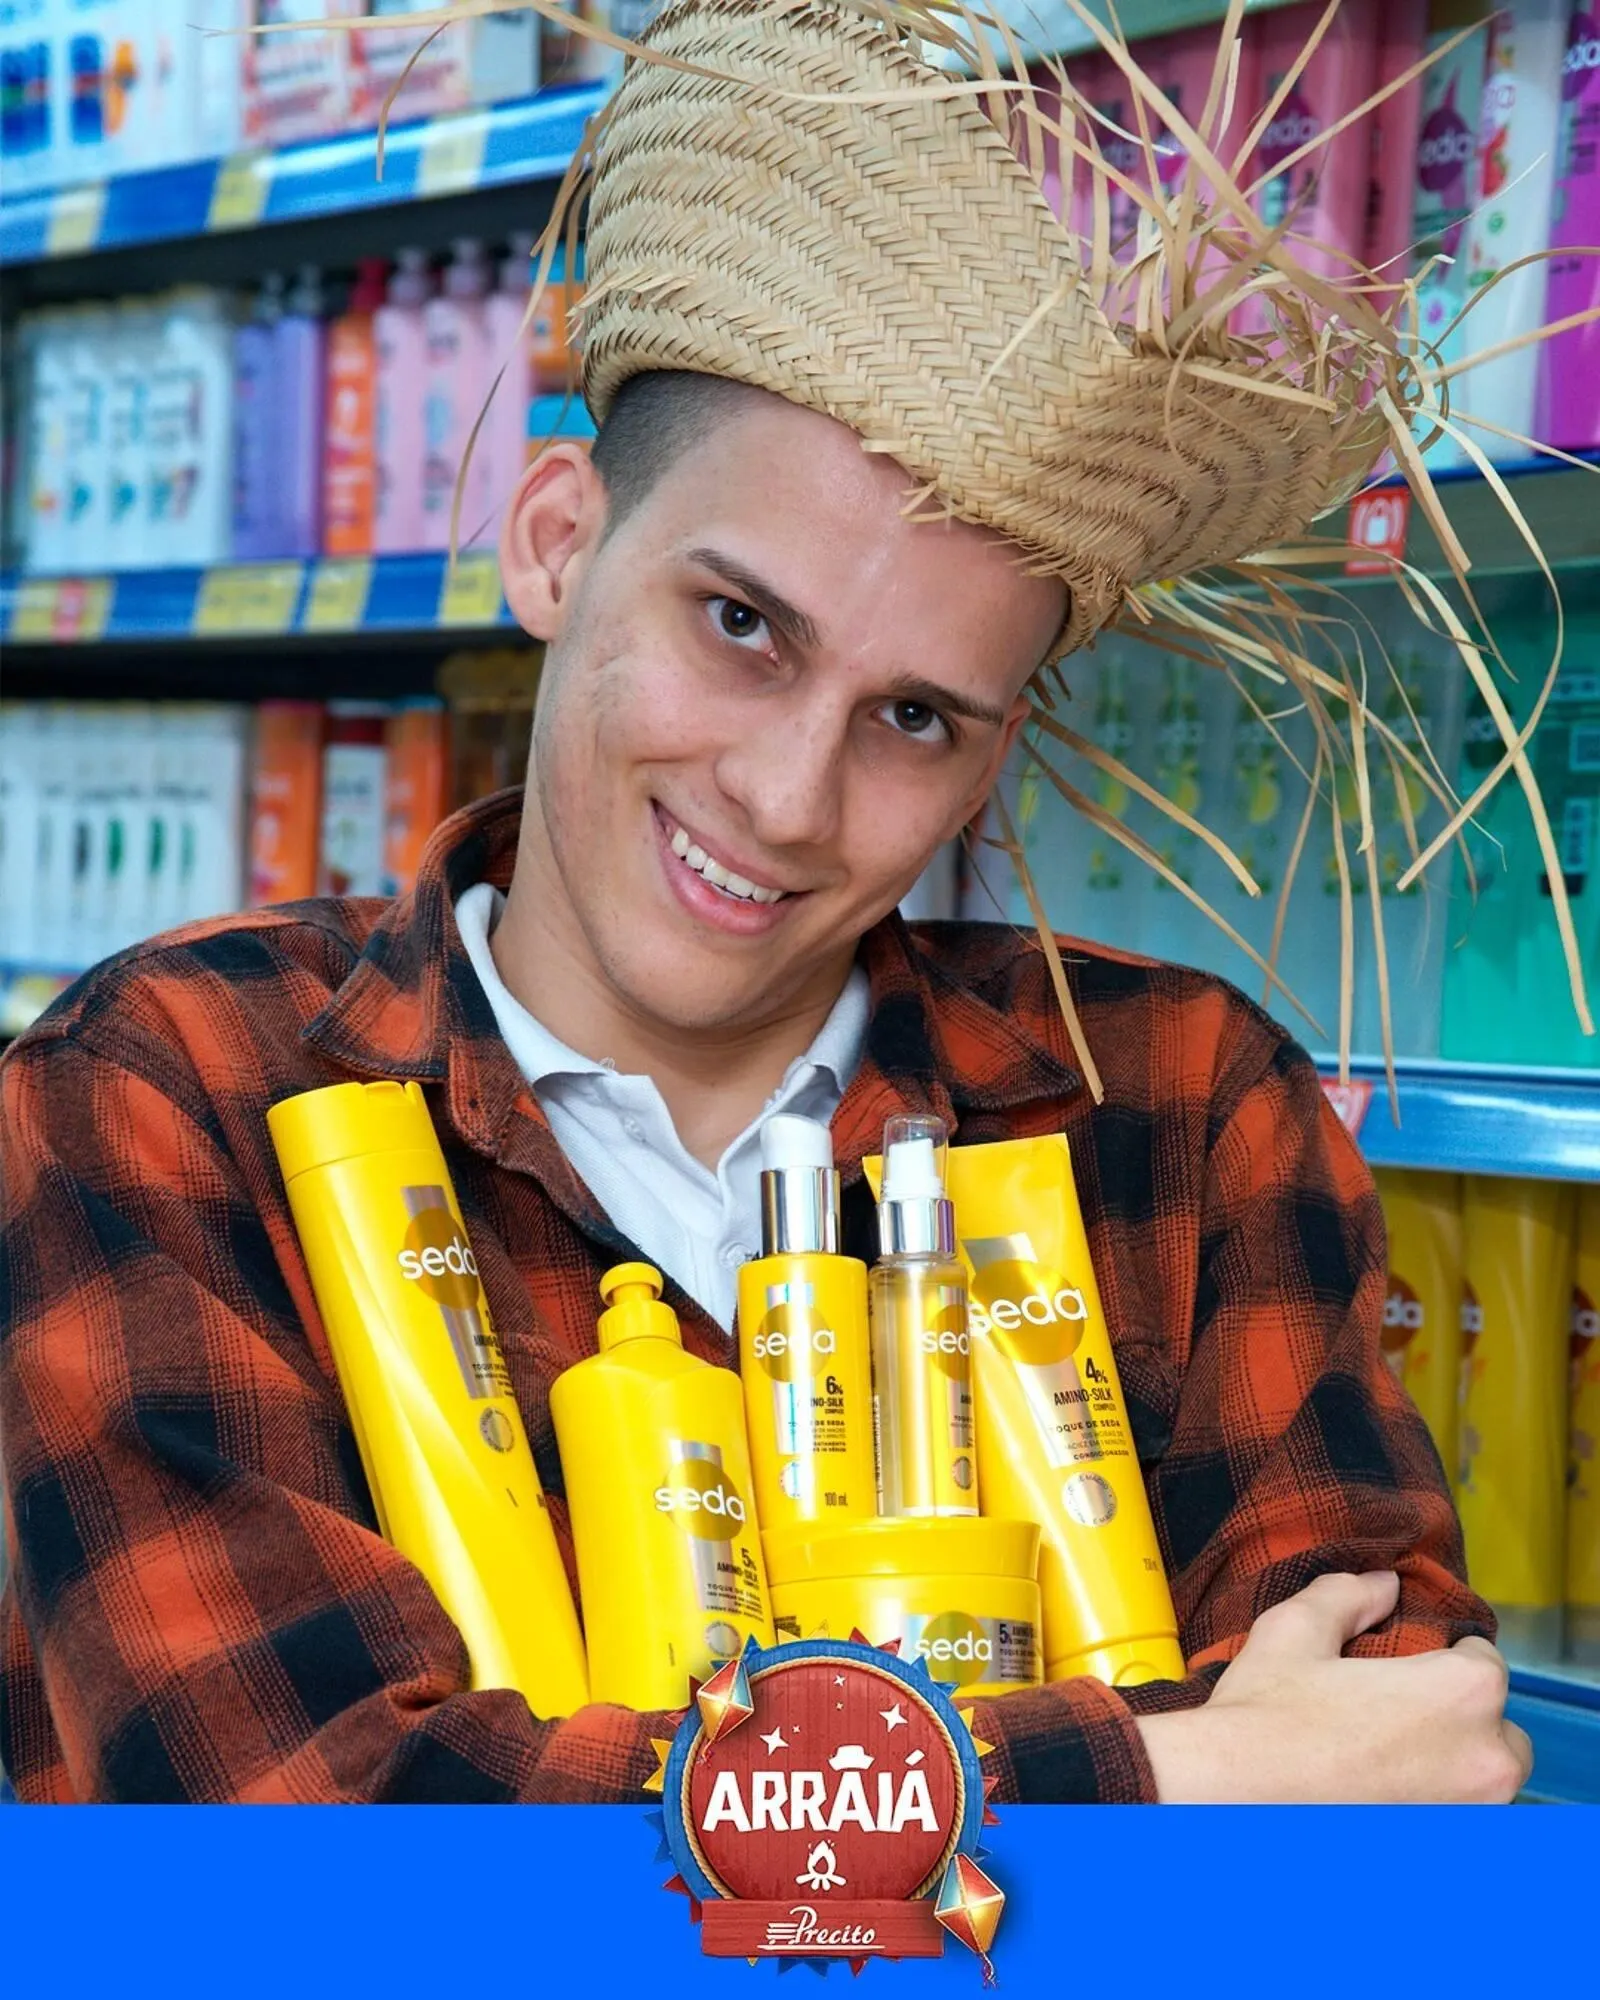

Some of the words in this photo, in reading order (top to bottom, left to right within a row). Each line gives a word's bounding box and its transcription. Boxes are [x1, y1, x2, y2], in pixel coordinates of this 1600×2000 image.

[398, 1236, 479, 1280] seda
[967, 1282, 1088, 1337] seda
[921, 1330, 970, 1356] sed
[1085, 1356, 1108, 1383] 4%
[825, 1375, 844, 1395] 6%
[1053, 1387, 1115, 1406] AMINO-SILK
[1085, 1420, 1098, 1429] DE
[654, 1484, 746, 1521] seda
[914, 1630, 993, 1662] seda
